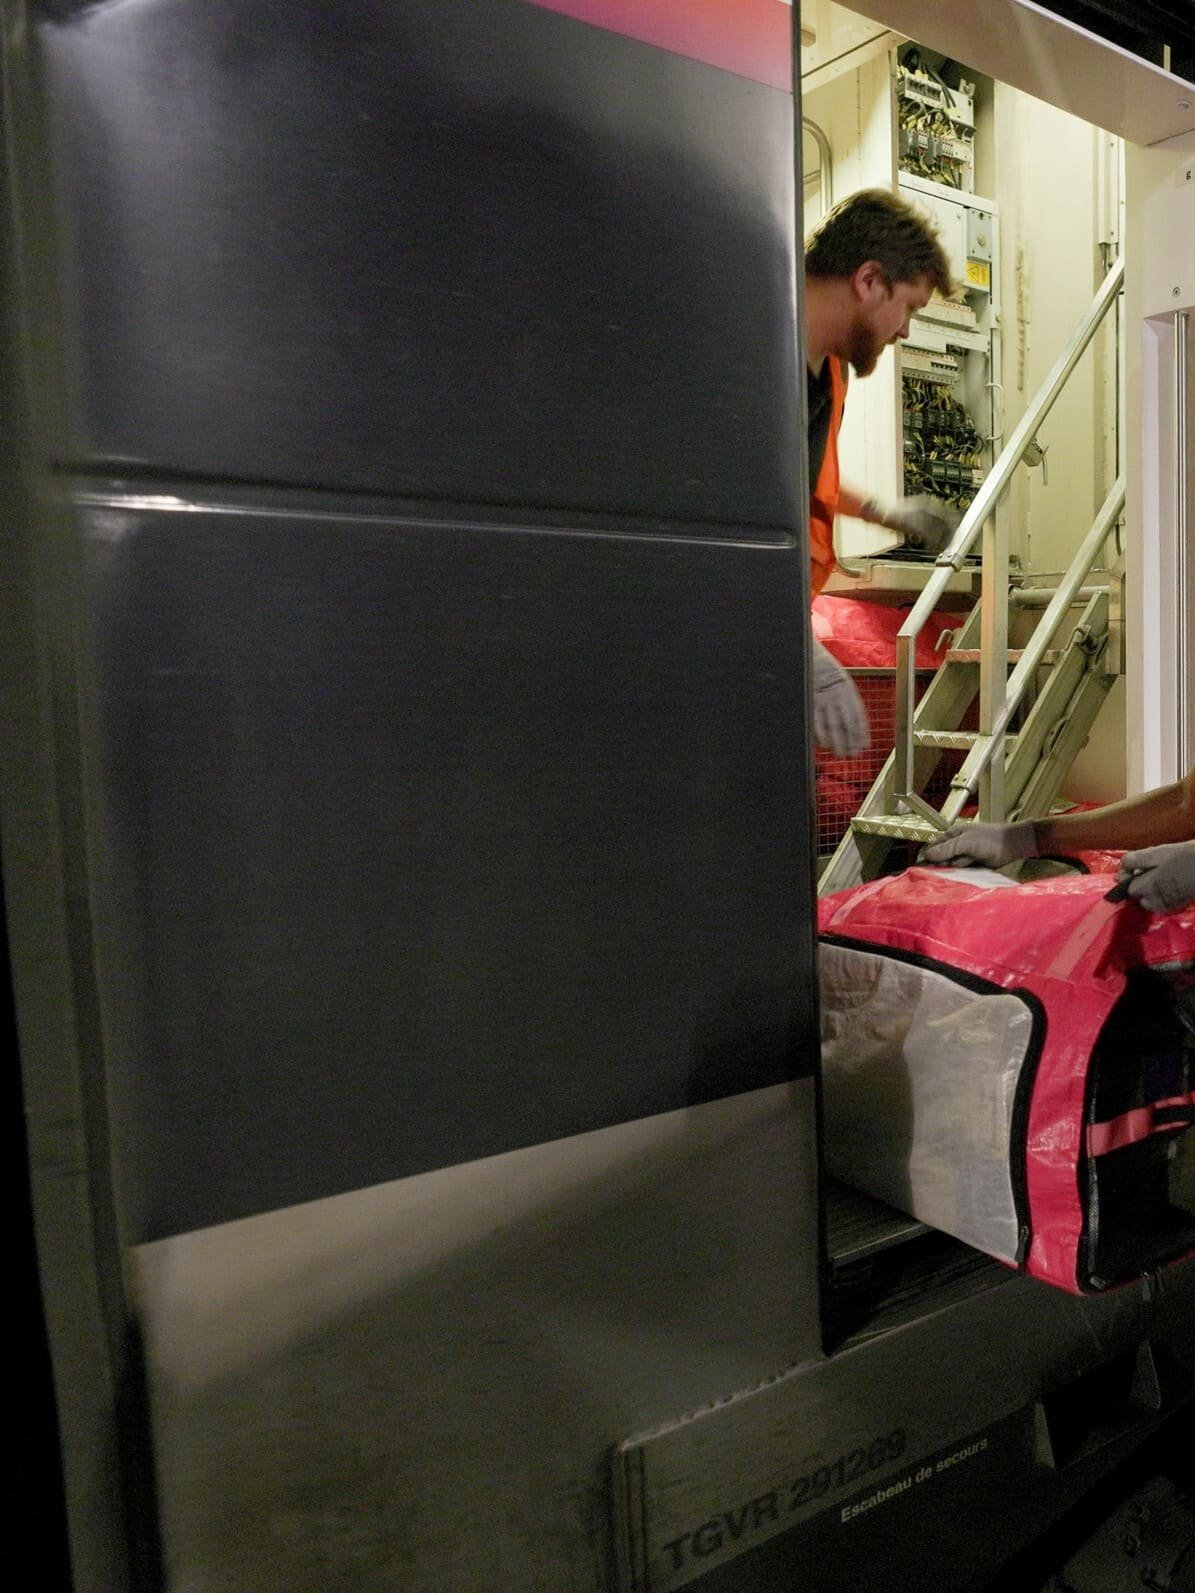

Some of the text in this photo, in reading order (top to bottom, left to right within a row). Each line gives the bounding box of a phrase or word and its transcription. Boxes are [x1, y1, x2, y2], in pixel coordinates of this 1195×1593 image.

[663, 1428, 907, 1570] TGVR 291269
[840, 1437, 988, 1523] Escabeau de secours
